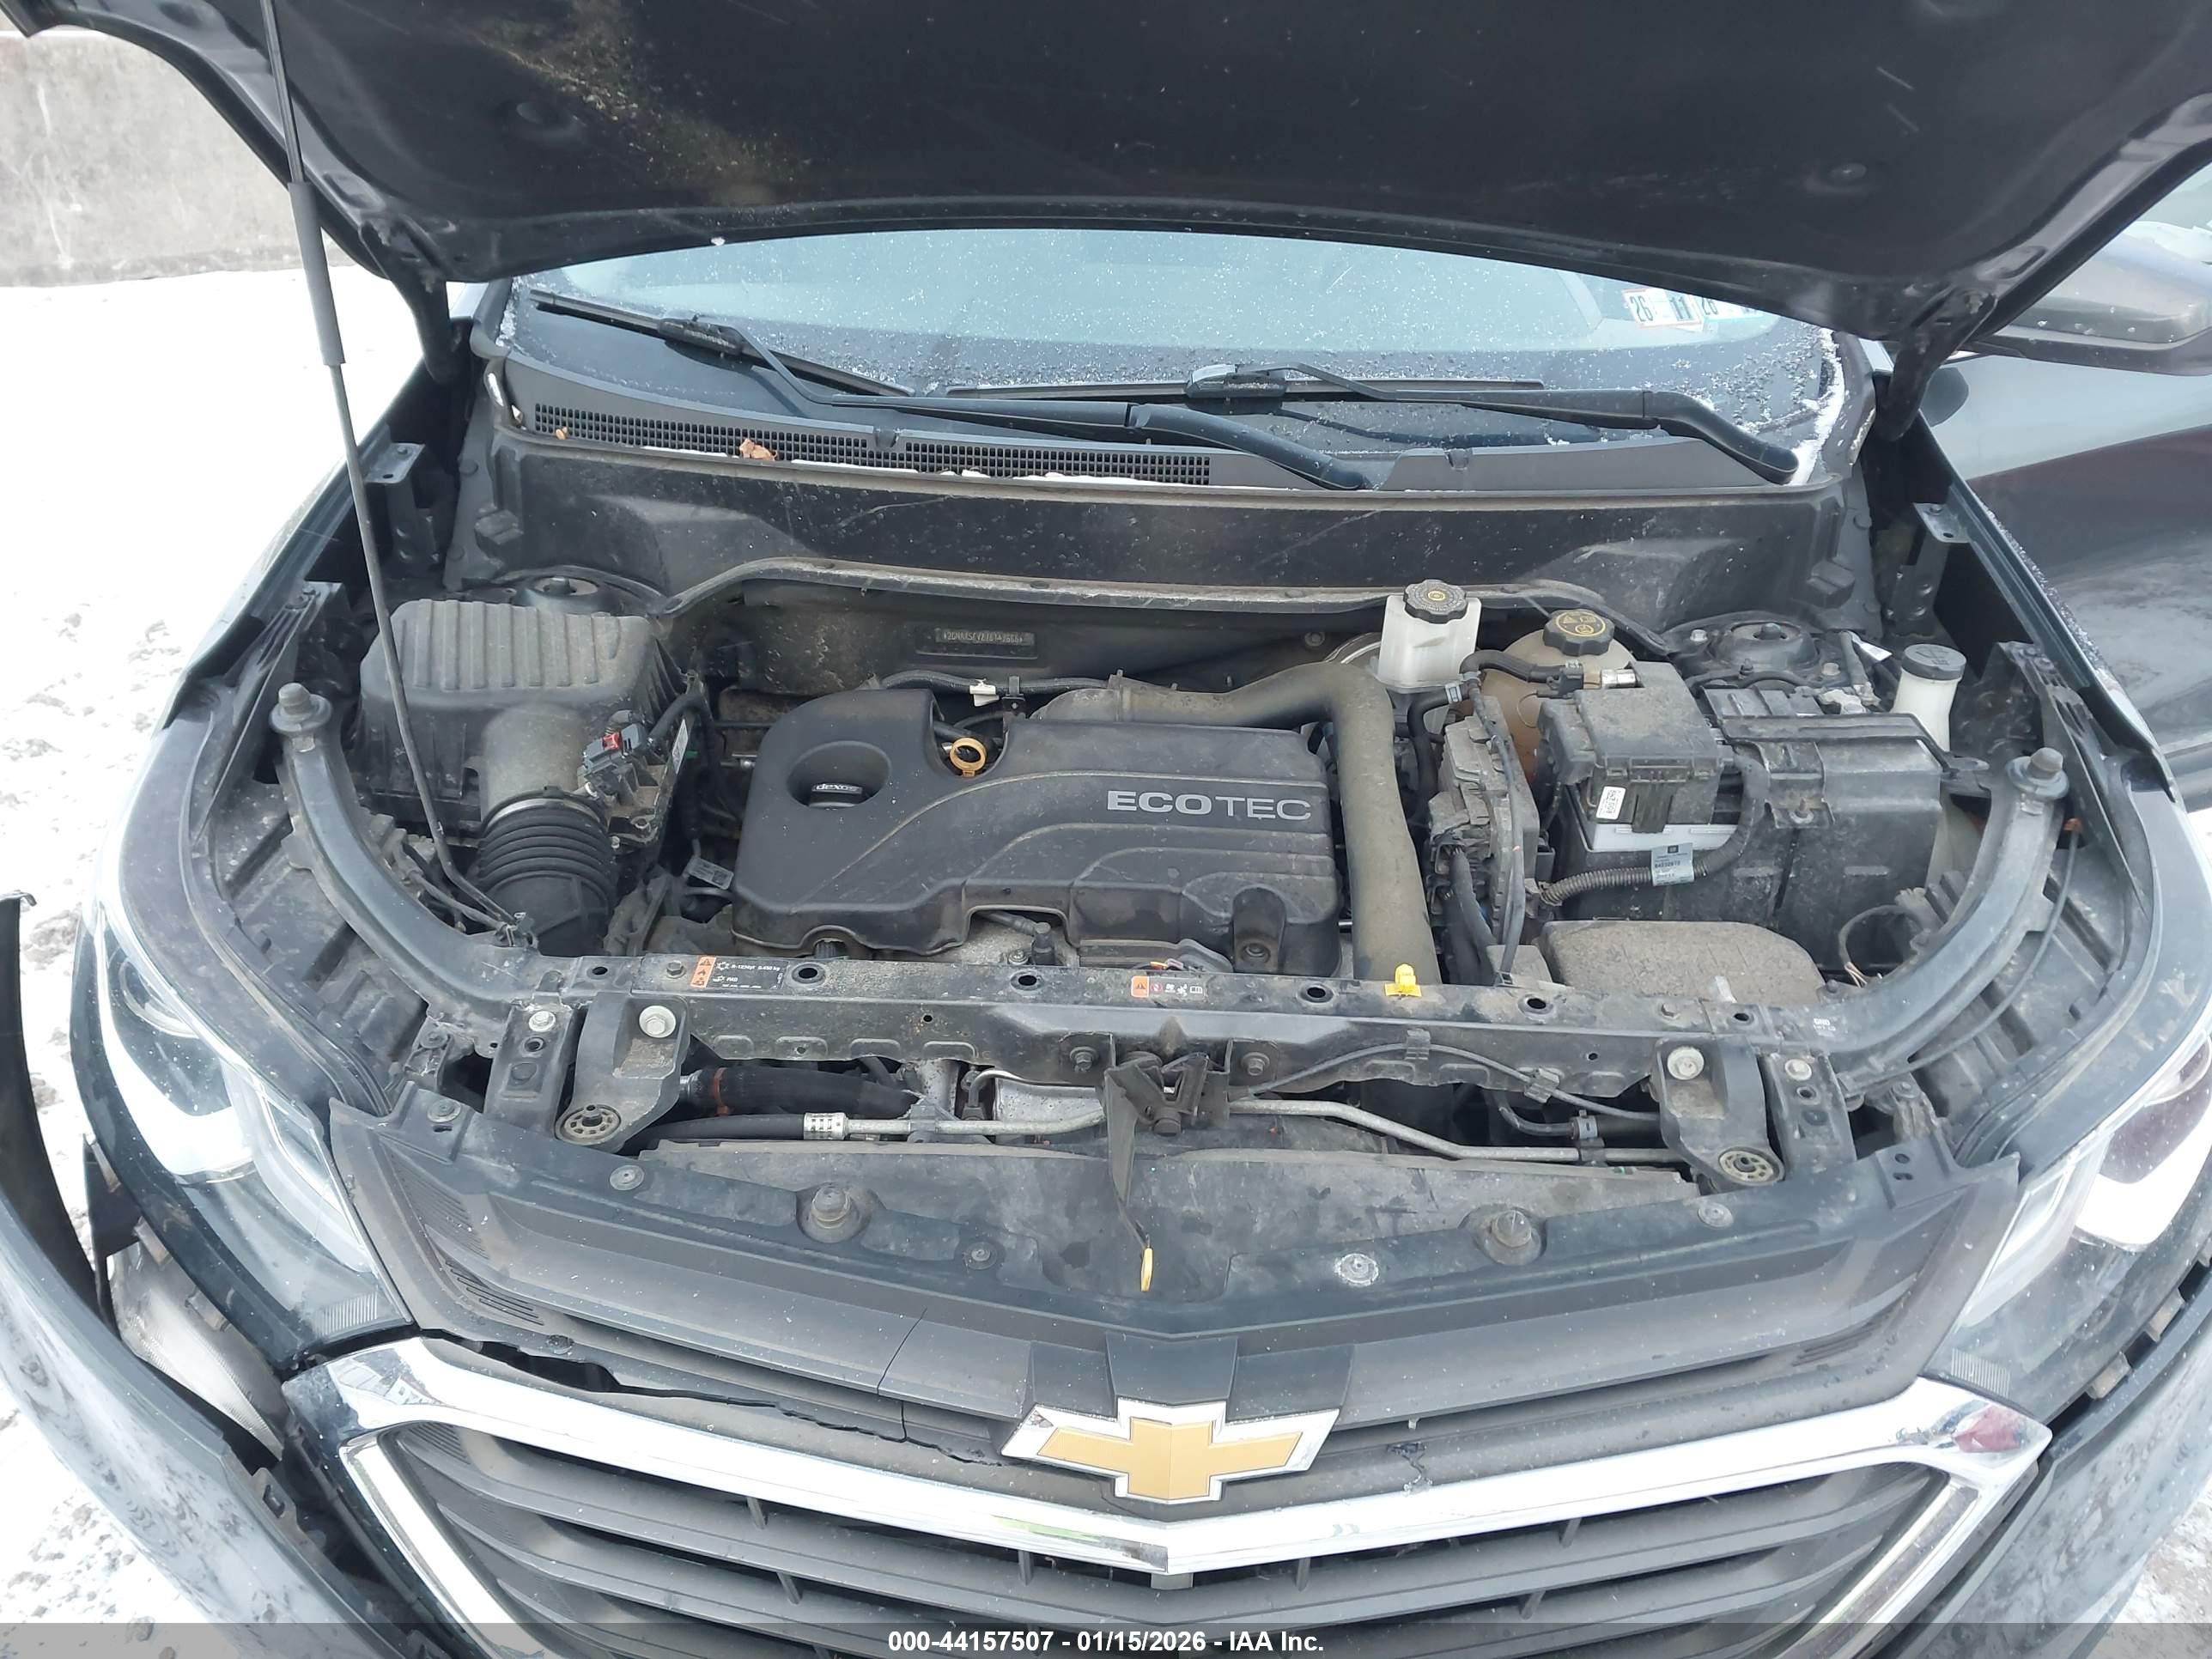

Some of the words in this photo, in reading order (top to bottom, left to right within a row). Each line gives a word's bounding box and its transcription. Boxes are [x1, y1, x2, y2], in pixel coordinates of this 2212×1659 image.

[1630, 295, 1654, 323] 26
[1669, 295, 1692, 321] 11
[1106, 789, 1312, 821] ECOTEC
